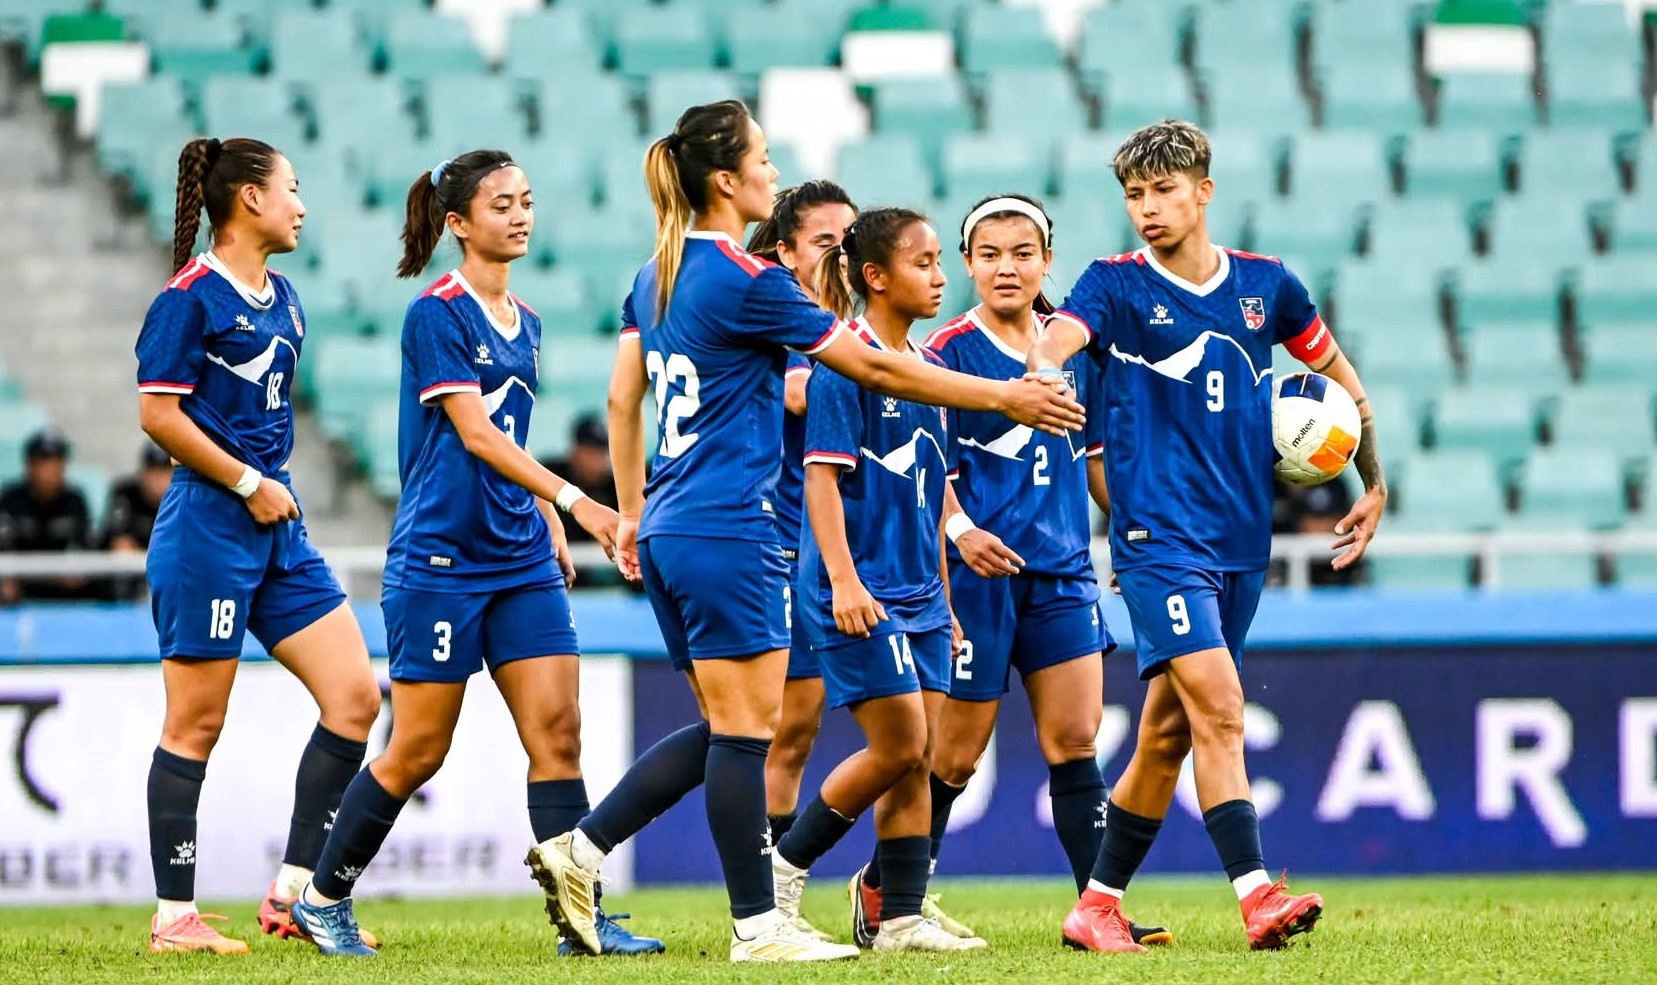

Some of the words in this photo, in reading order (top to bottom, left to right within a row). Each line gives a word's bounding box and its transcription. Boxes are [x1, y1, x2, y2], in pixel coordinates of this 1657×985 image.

[265, 372, 284, 411] 18
[1206, 370, 1225, 412] 9
[881, 411, 901, 419] KELME
[1292, 418, 1316, 448] molten
[1032, 445, 1051, 486] 2
[209, 598, 236, 640] 18
[1166, 594, 1191, 636] 9
[432, 620, 452, 662] 3
[887, 632, 917, 676] 14
[955, 639, 974, 681] 2
